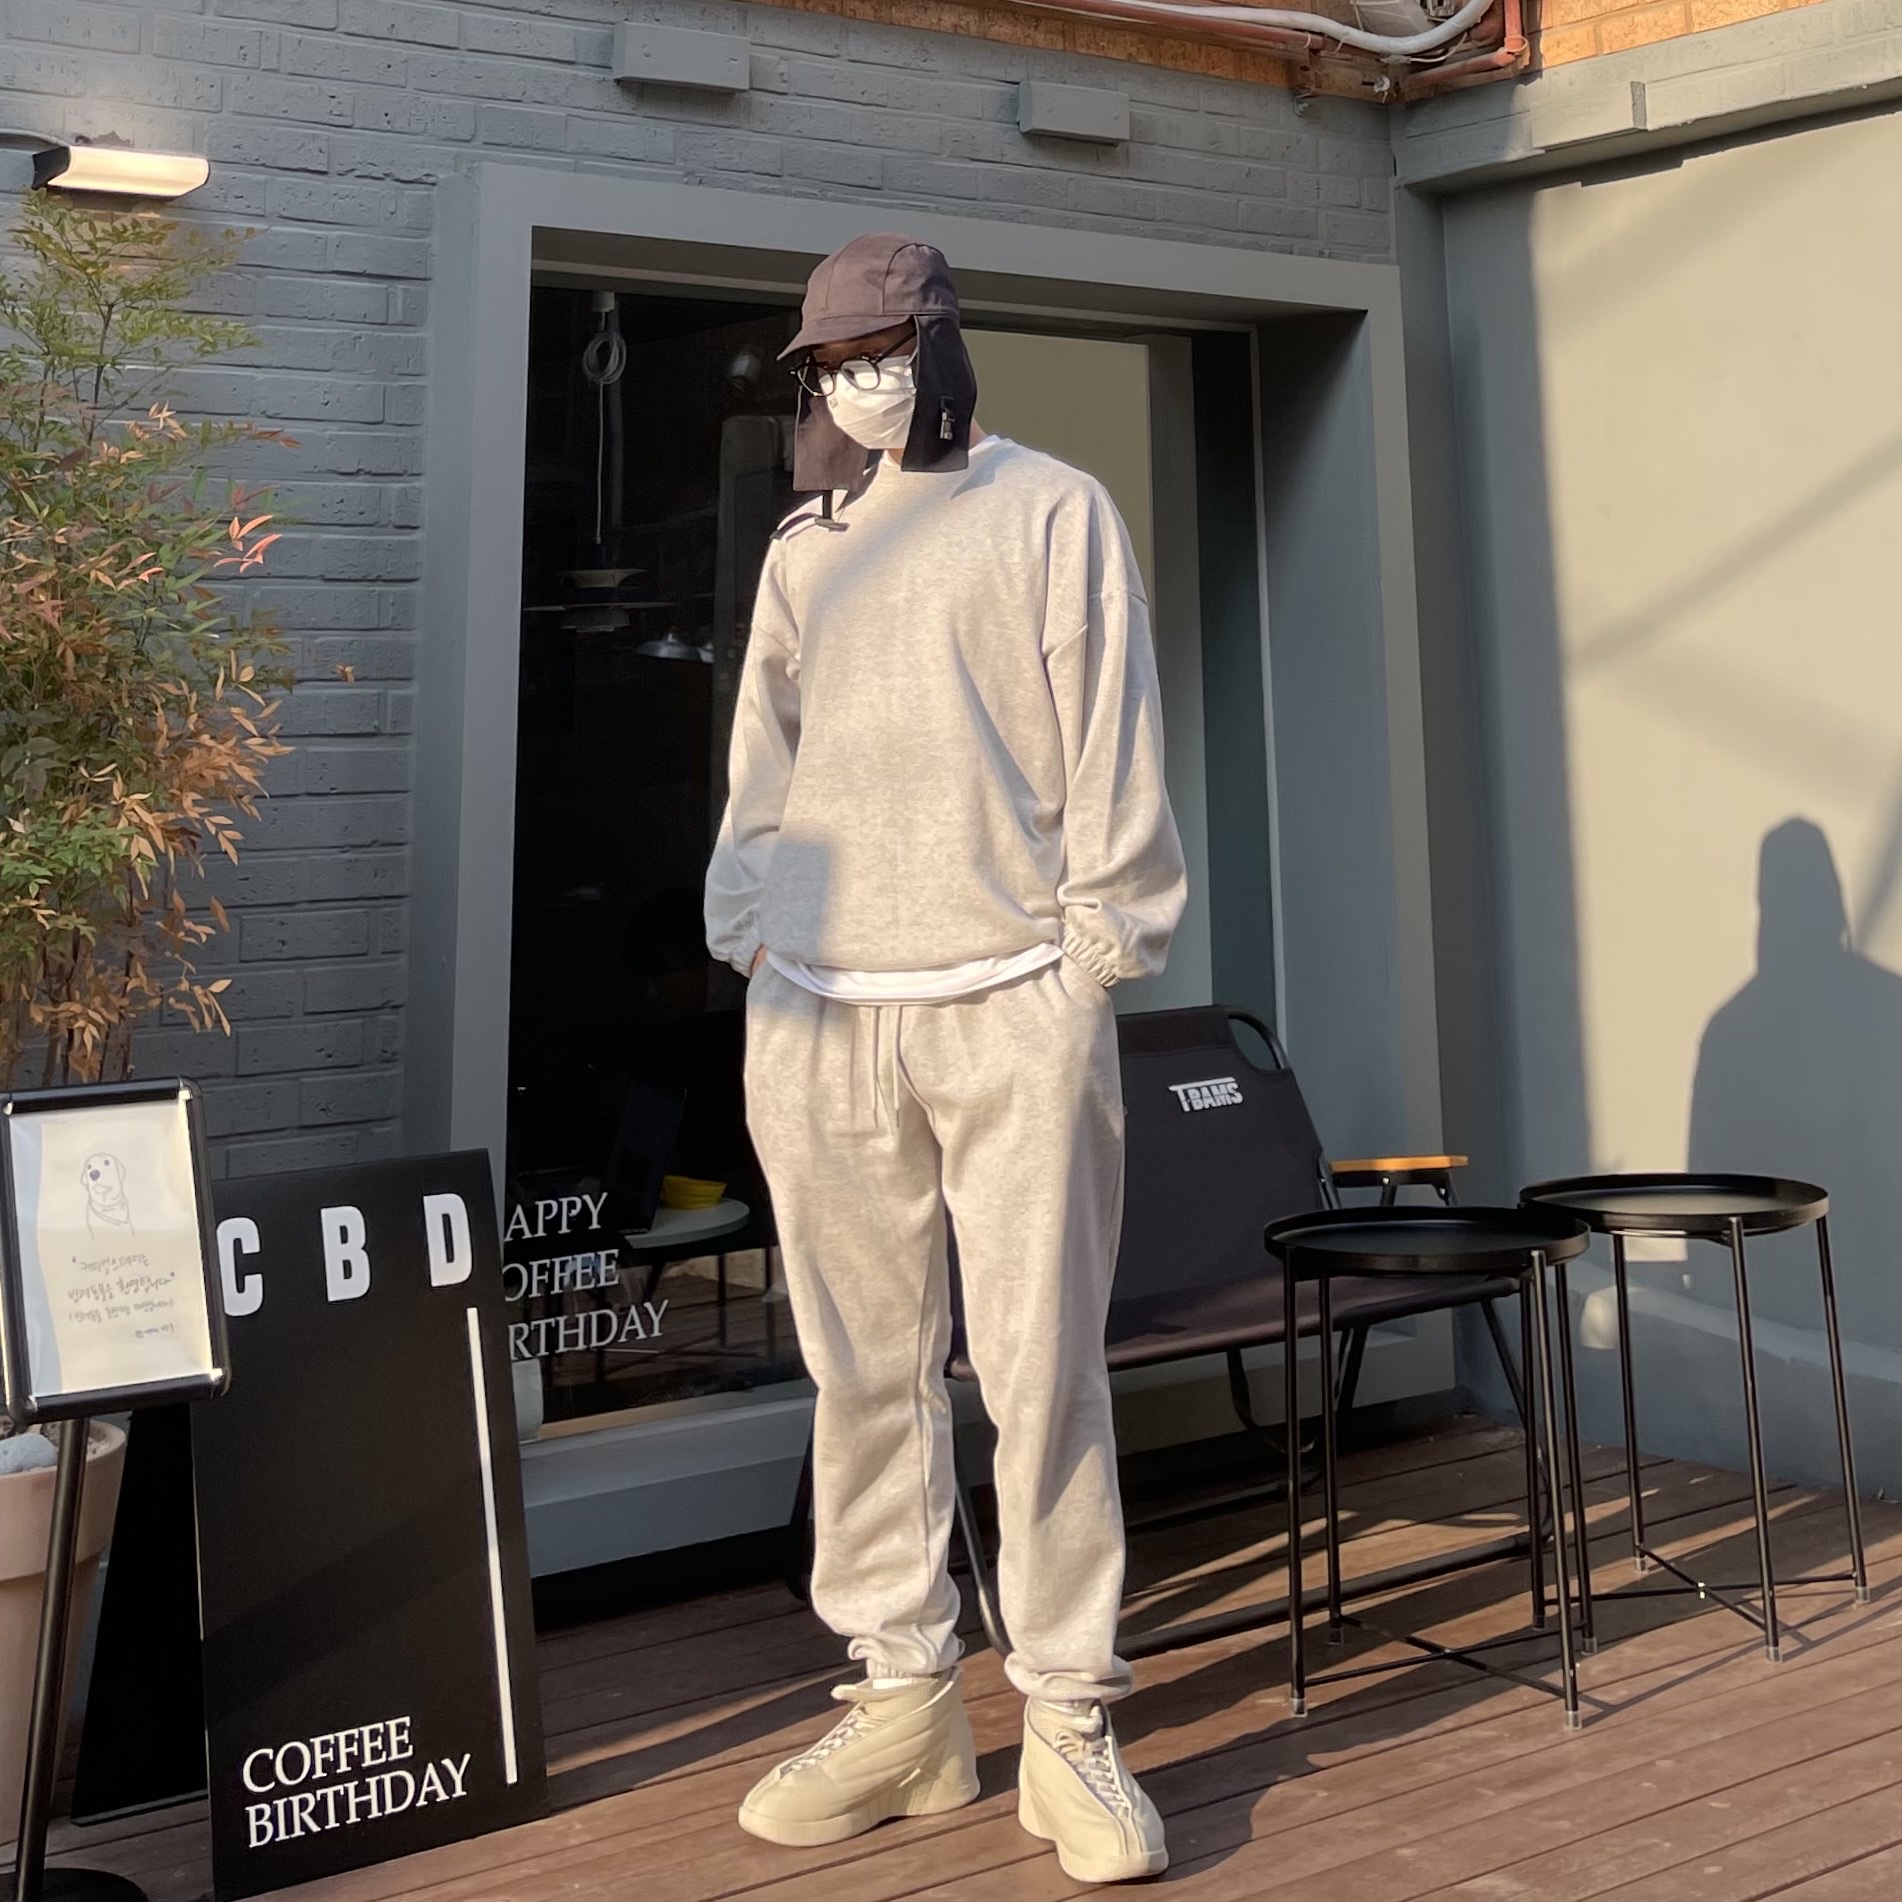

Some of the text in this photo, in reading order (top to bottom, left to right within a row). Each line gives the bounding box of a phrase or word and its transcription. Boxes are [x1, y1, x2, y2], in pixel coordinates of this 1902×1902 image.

[503, 1192, 609, 1242] APPY
[502, 1249, 620, 1302] OFFEE
[508, 1299, 670, 1361] RTHDAY
[242, 1716, 414, 1793] COFFEE
[245, 1753, 471, 1848] BIRTHDAY
